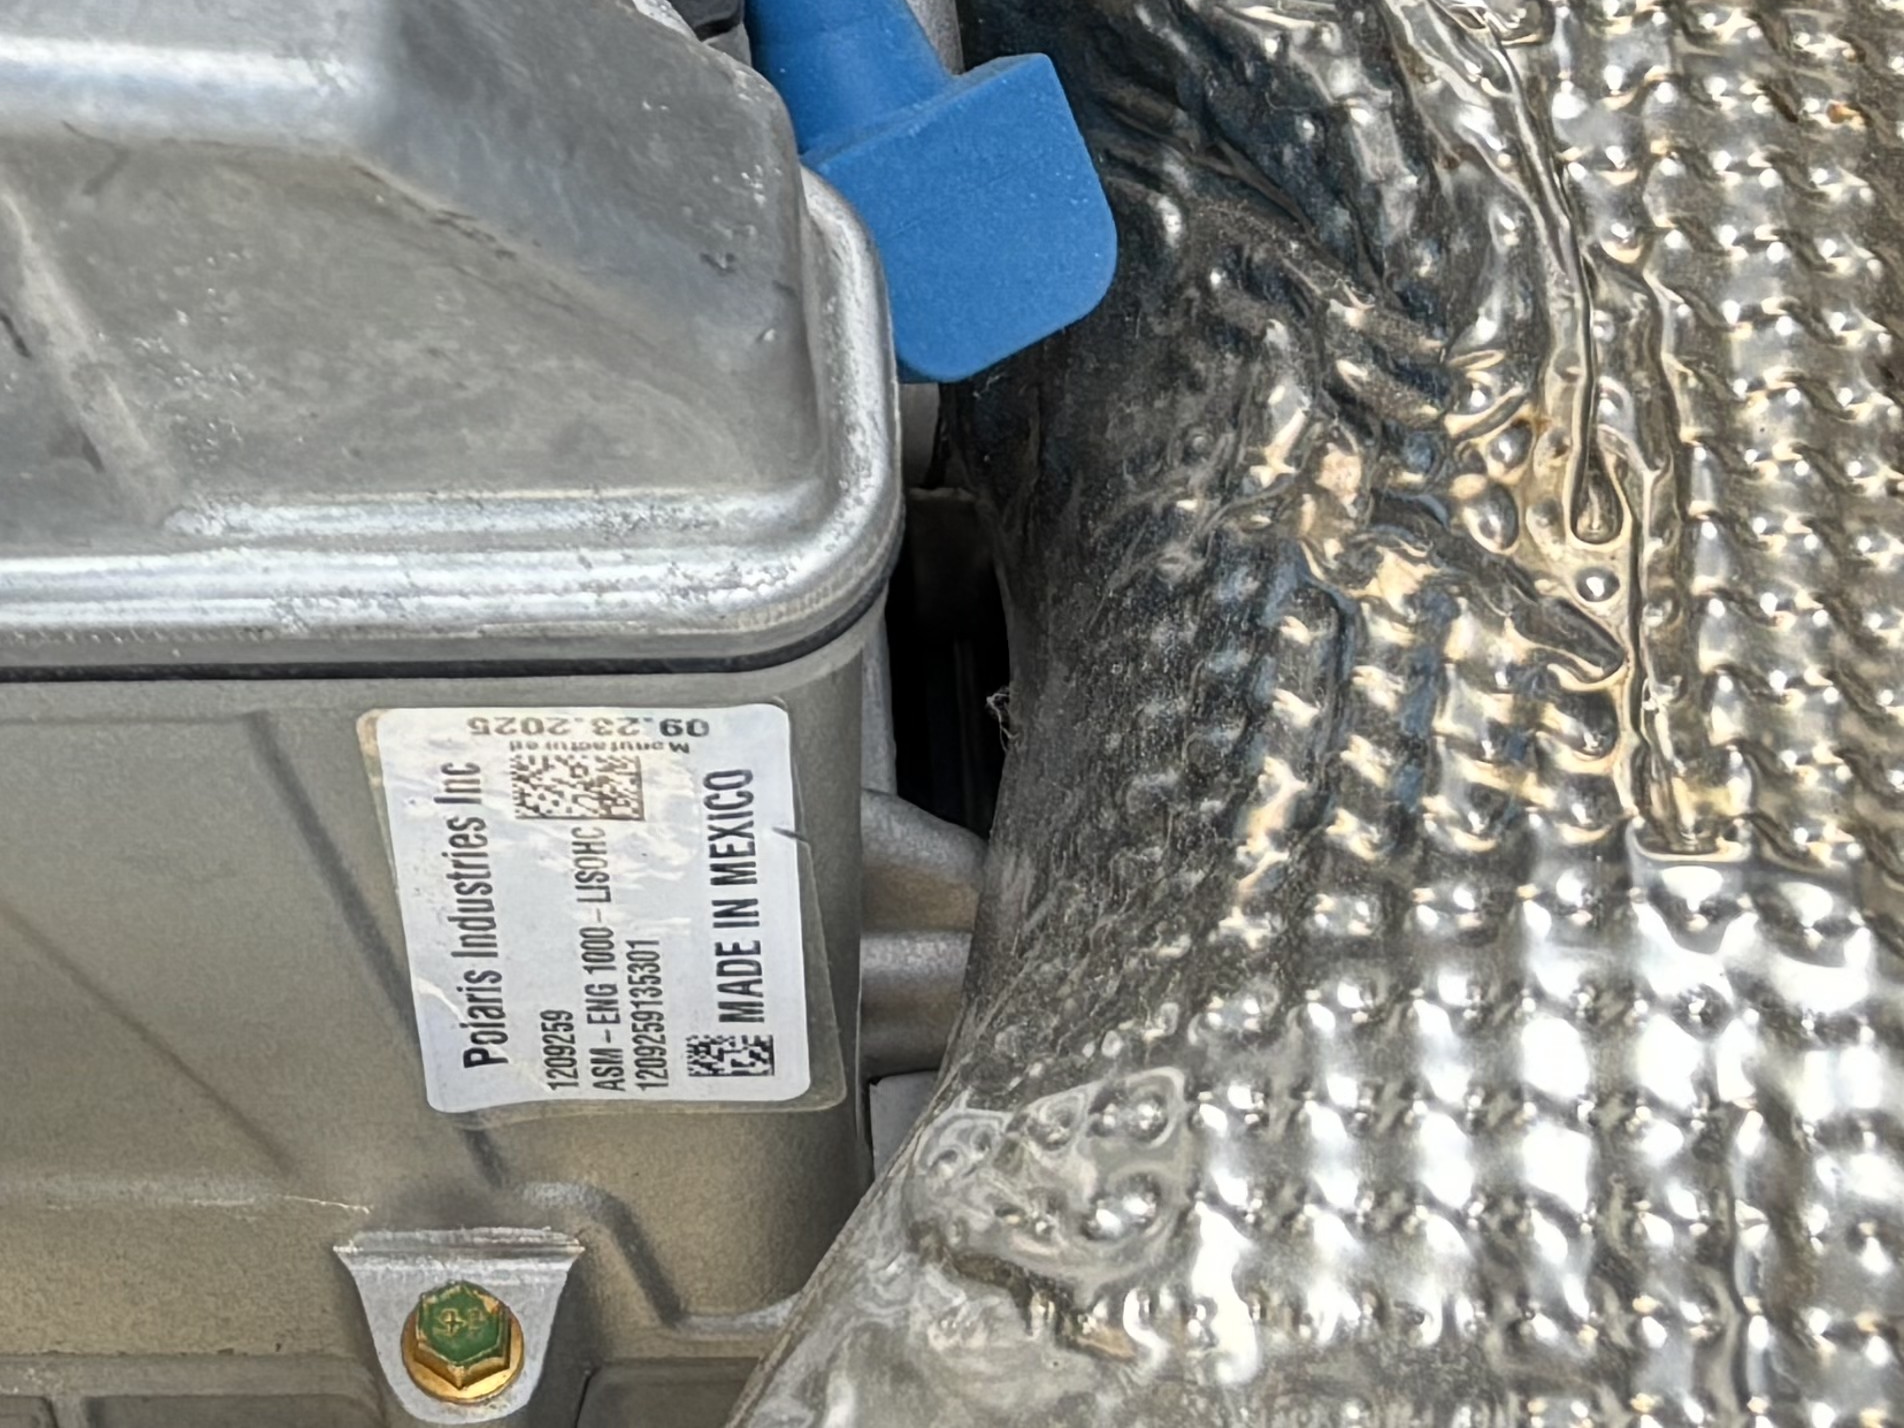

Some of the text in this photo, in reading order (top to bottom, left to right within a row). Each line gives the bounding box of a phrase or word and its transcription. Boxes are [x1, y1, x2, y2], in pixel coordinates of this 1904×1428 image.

[467, 715, 711, 738] 09.23.2025
[433, 761, 510, 1070] Polaris Industries Inc
[702, 768, 766, 1025] MADE IN MEXICO
[539, 1008, 580, 1092] 1209259
[623, 939, 670, 1092] 1209259135301
